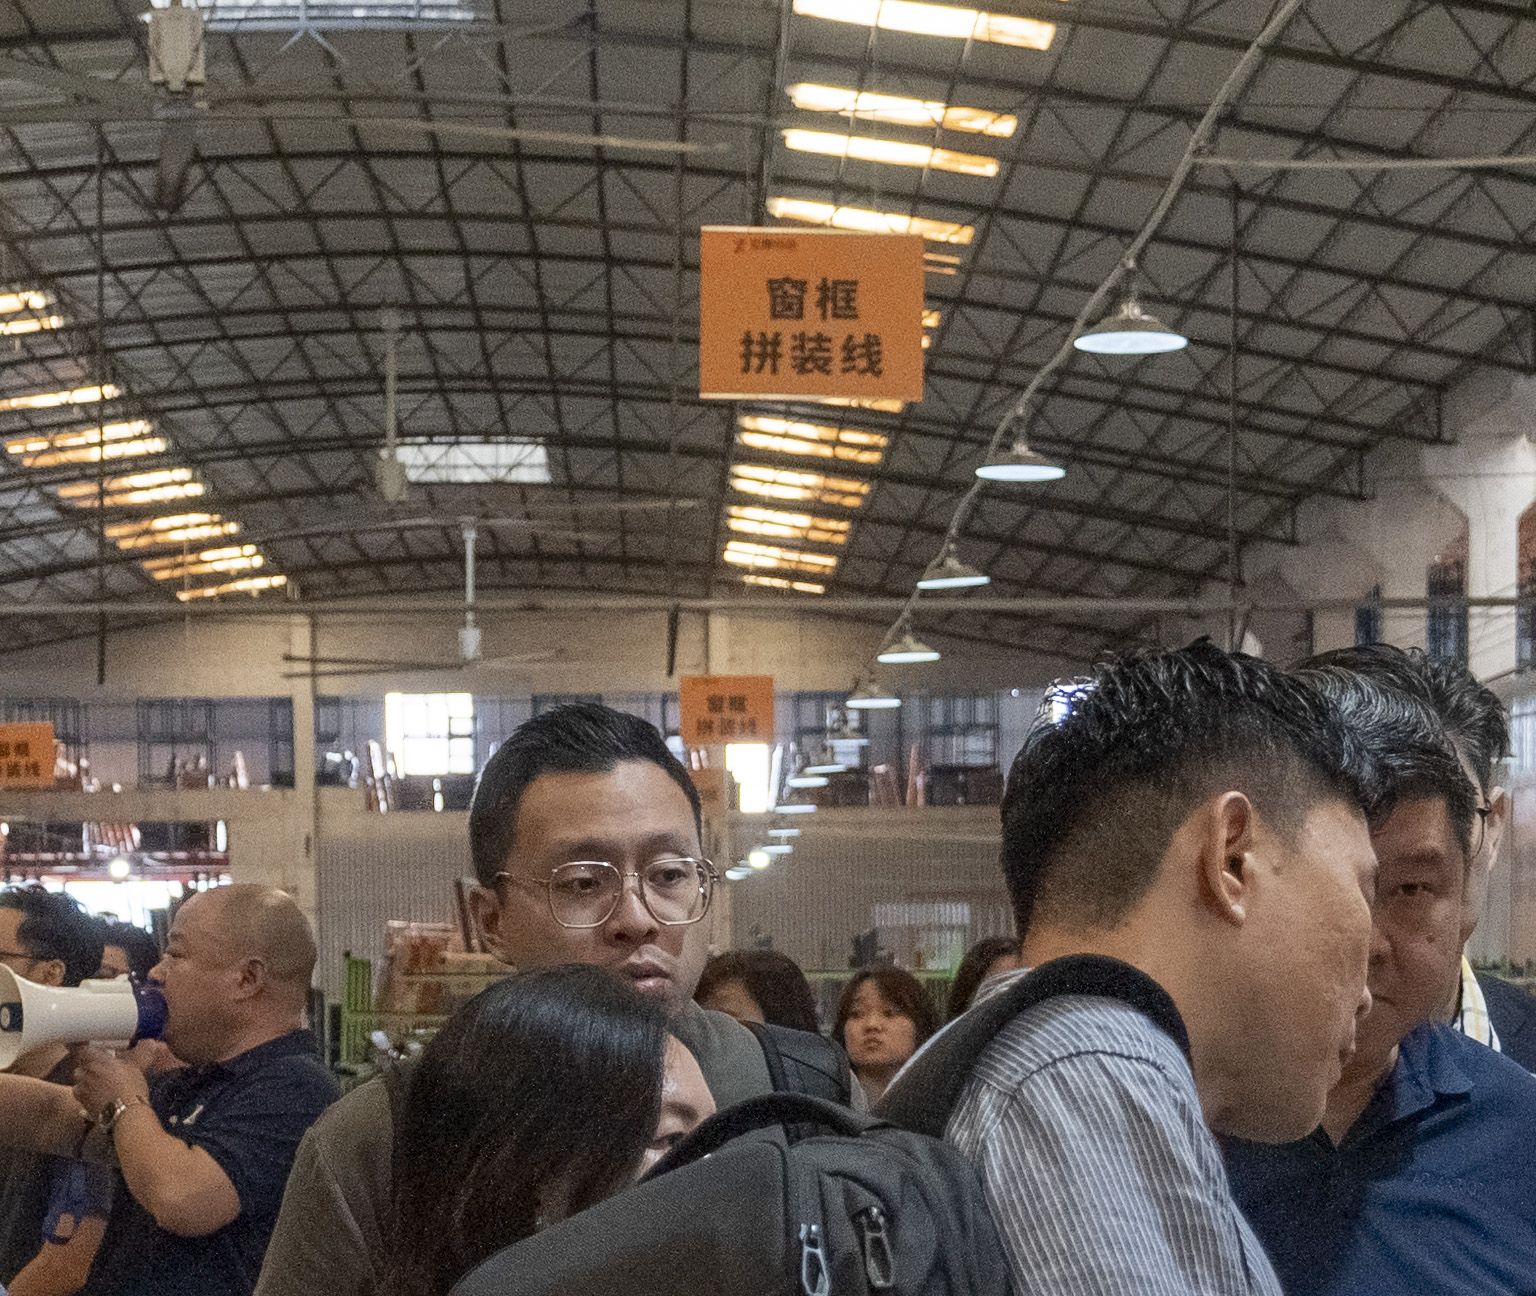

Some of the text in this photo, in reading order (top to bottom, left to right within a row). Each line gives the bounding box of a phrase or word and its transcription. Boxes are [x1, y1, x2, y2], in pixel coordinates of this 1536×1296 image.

[767, 276, 859, 321] 窗框
[740, 330, 883, 377] 拼装线
